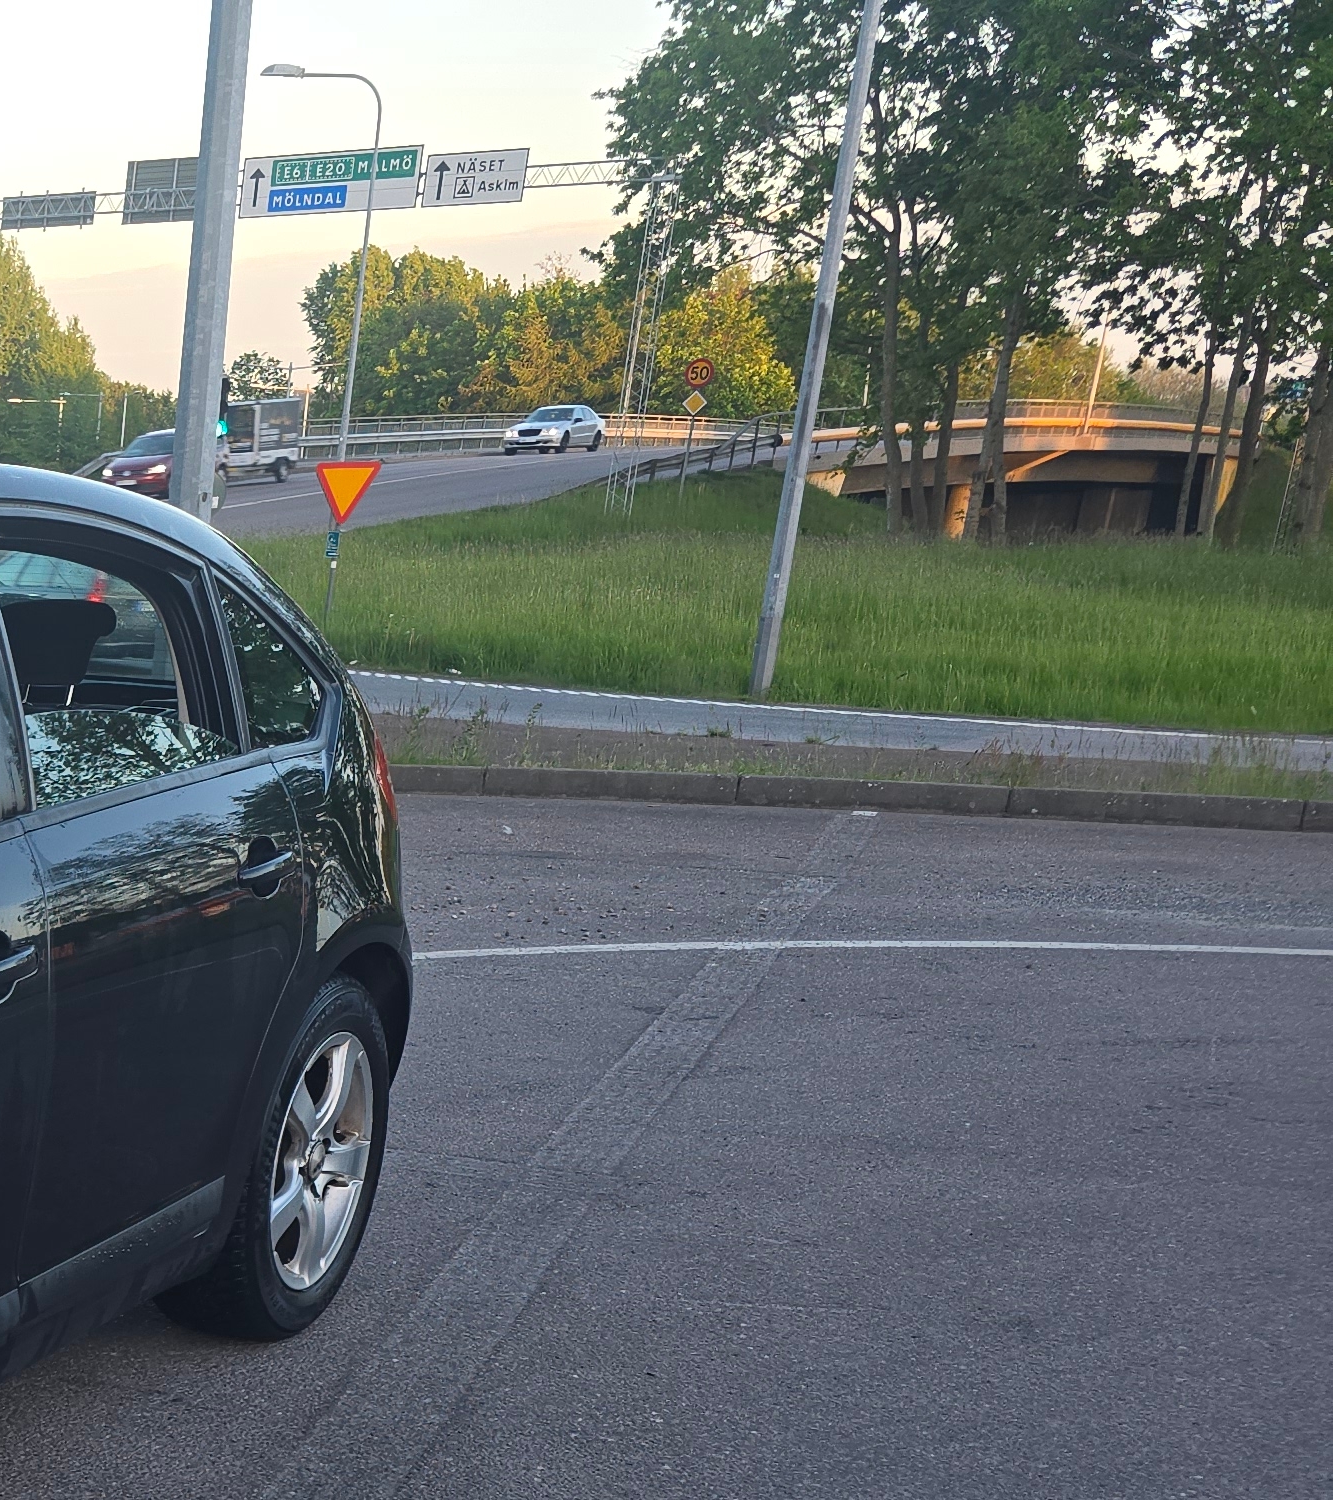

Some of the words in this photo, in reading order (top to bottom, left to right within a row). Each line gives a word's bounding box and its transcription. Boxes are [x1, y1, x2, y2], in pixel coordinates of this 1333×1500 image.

[283, 166, 301, 179] E6
[316, 162, 345, 177] E20
[456, 157, 505, 174] NÄSET
[477, 179, 519, 193] Askim
[272, 191, 343, 208] MÖLNDAL
[690, 365, 710, 381] 50
